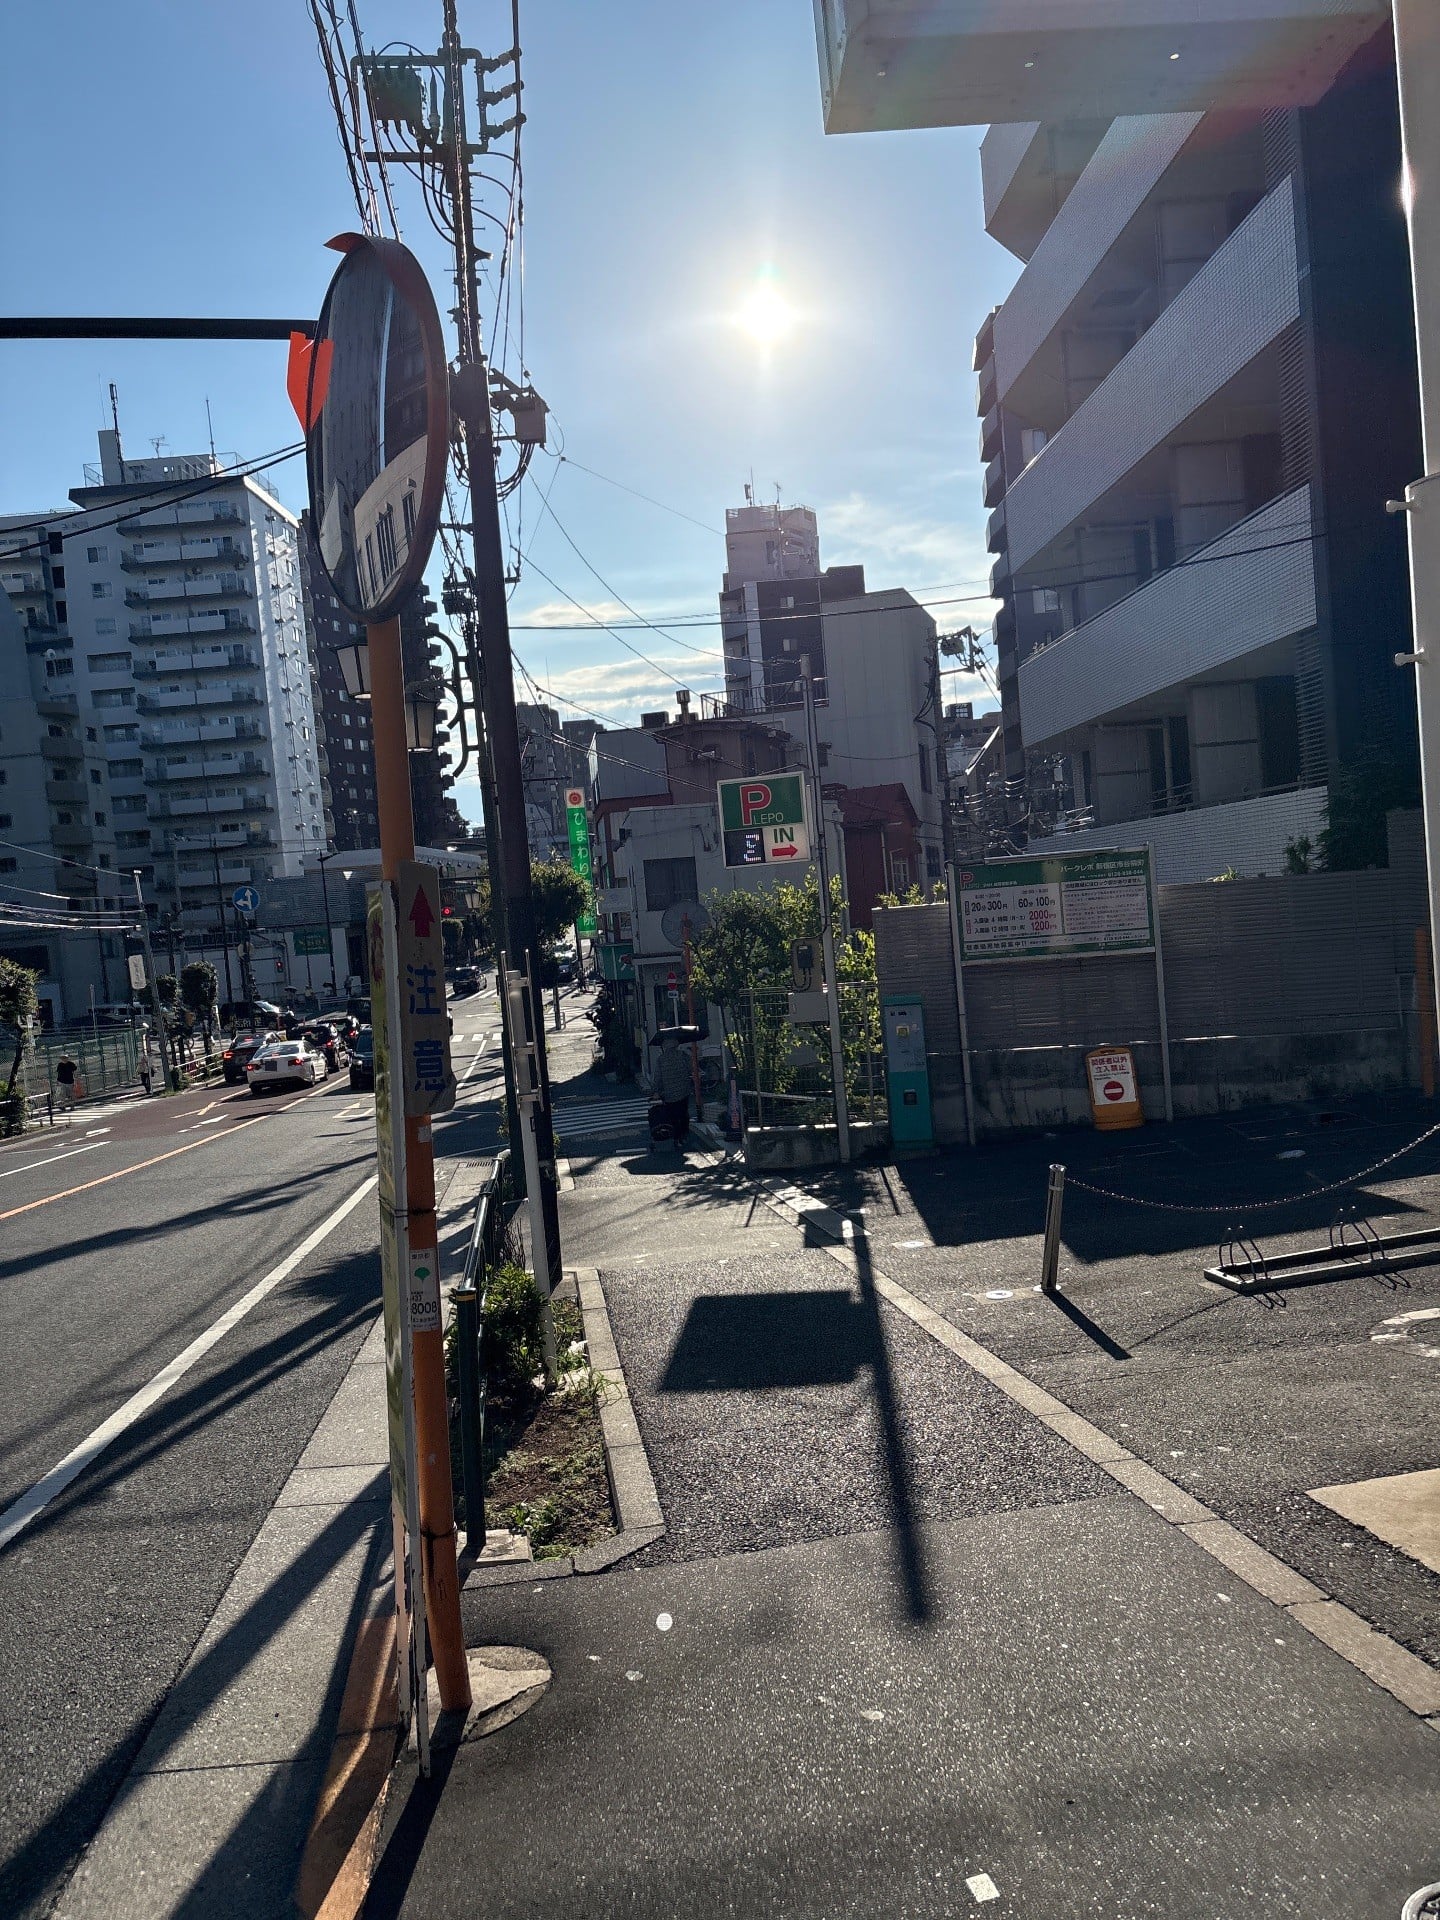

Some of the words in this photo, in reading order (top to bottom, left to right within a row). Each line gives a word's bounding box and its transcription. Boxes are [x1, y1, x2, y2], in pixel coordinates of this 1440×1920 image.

[739, 783, 772, 826] P
[753, 812, 784, 825] LEPO
[773, 827, 794, 844] IN
[573, 812, 596, 928] ひまわり院
[406, 963, 446, 1092] 注意
[1091, 1056, 1128, 1066] 関係者以外
[1095, 1064, 1127, 1073] 立入禁止
